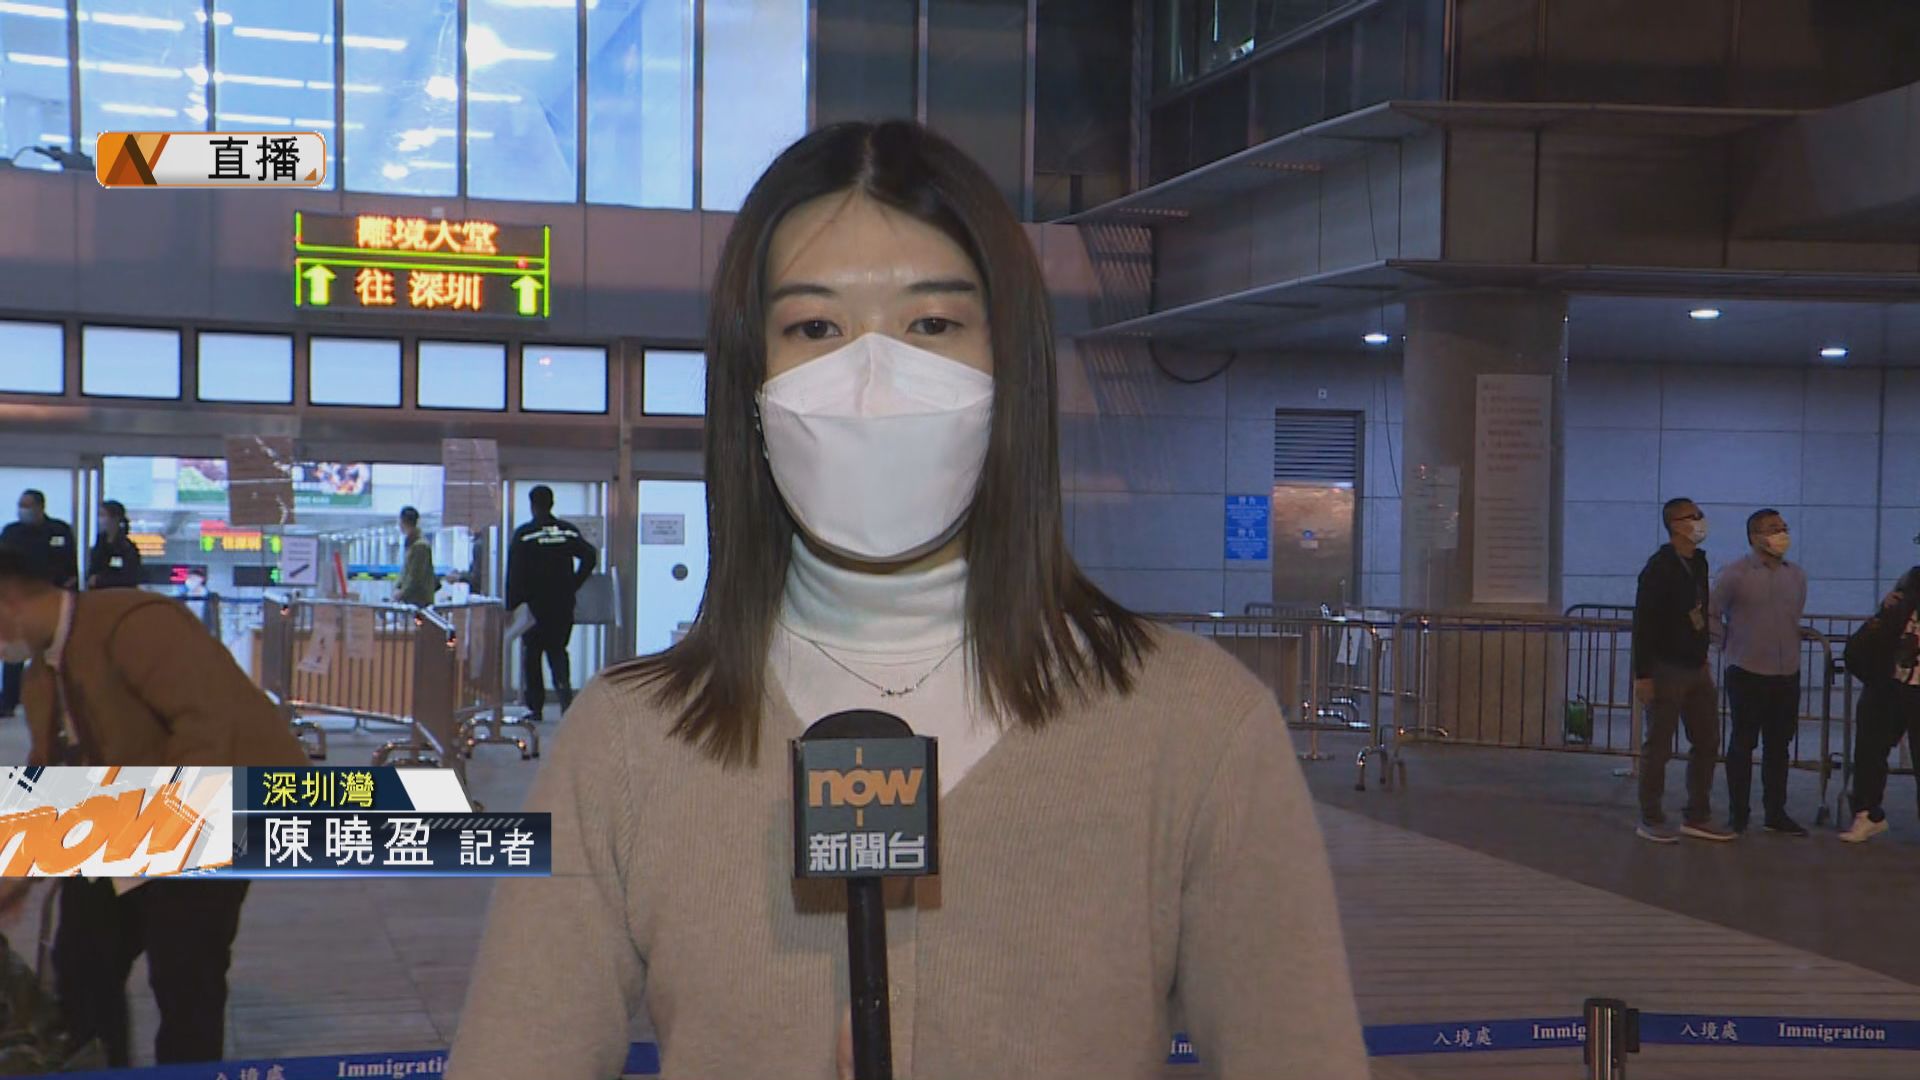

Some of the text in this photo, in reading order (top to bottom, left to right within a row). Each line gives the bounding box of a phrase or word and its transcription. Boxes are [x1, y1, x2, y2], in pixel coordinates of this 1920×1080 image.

[355, 267, 483, 311] 往 深圳
[808, 767, 923, 808] now
[808, 831, 926, 872] 新聞台
[1432, 1025, 1493, 1048] 入境處
[1680, 1020, 1886, 1042] 入境處 Immigration
